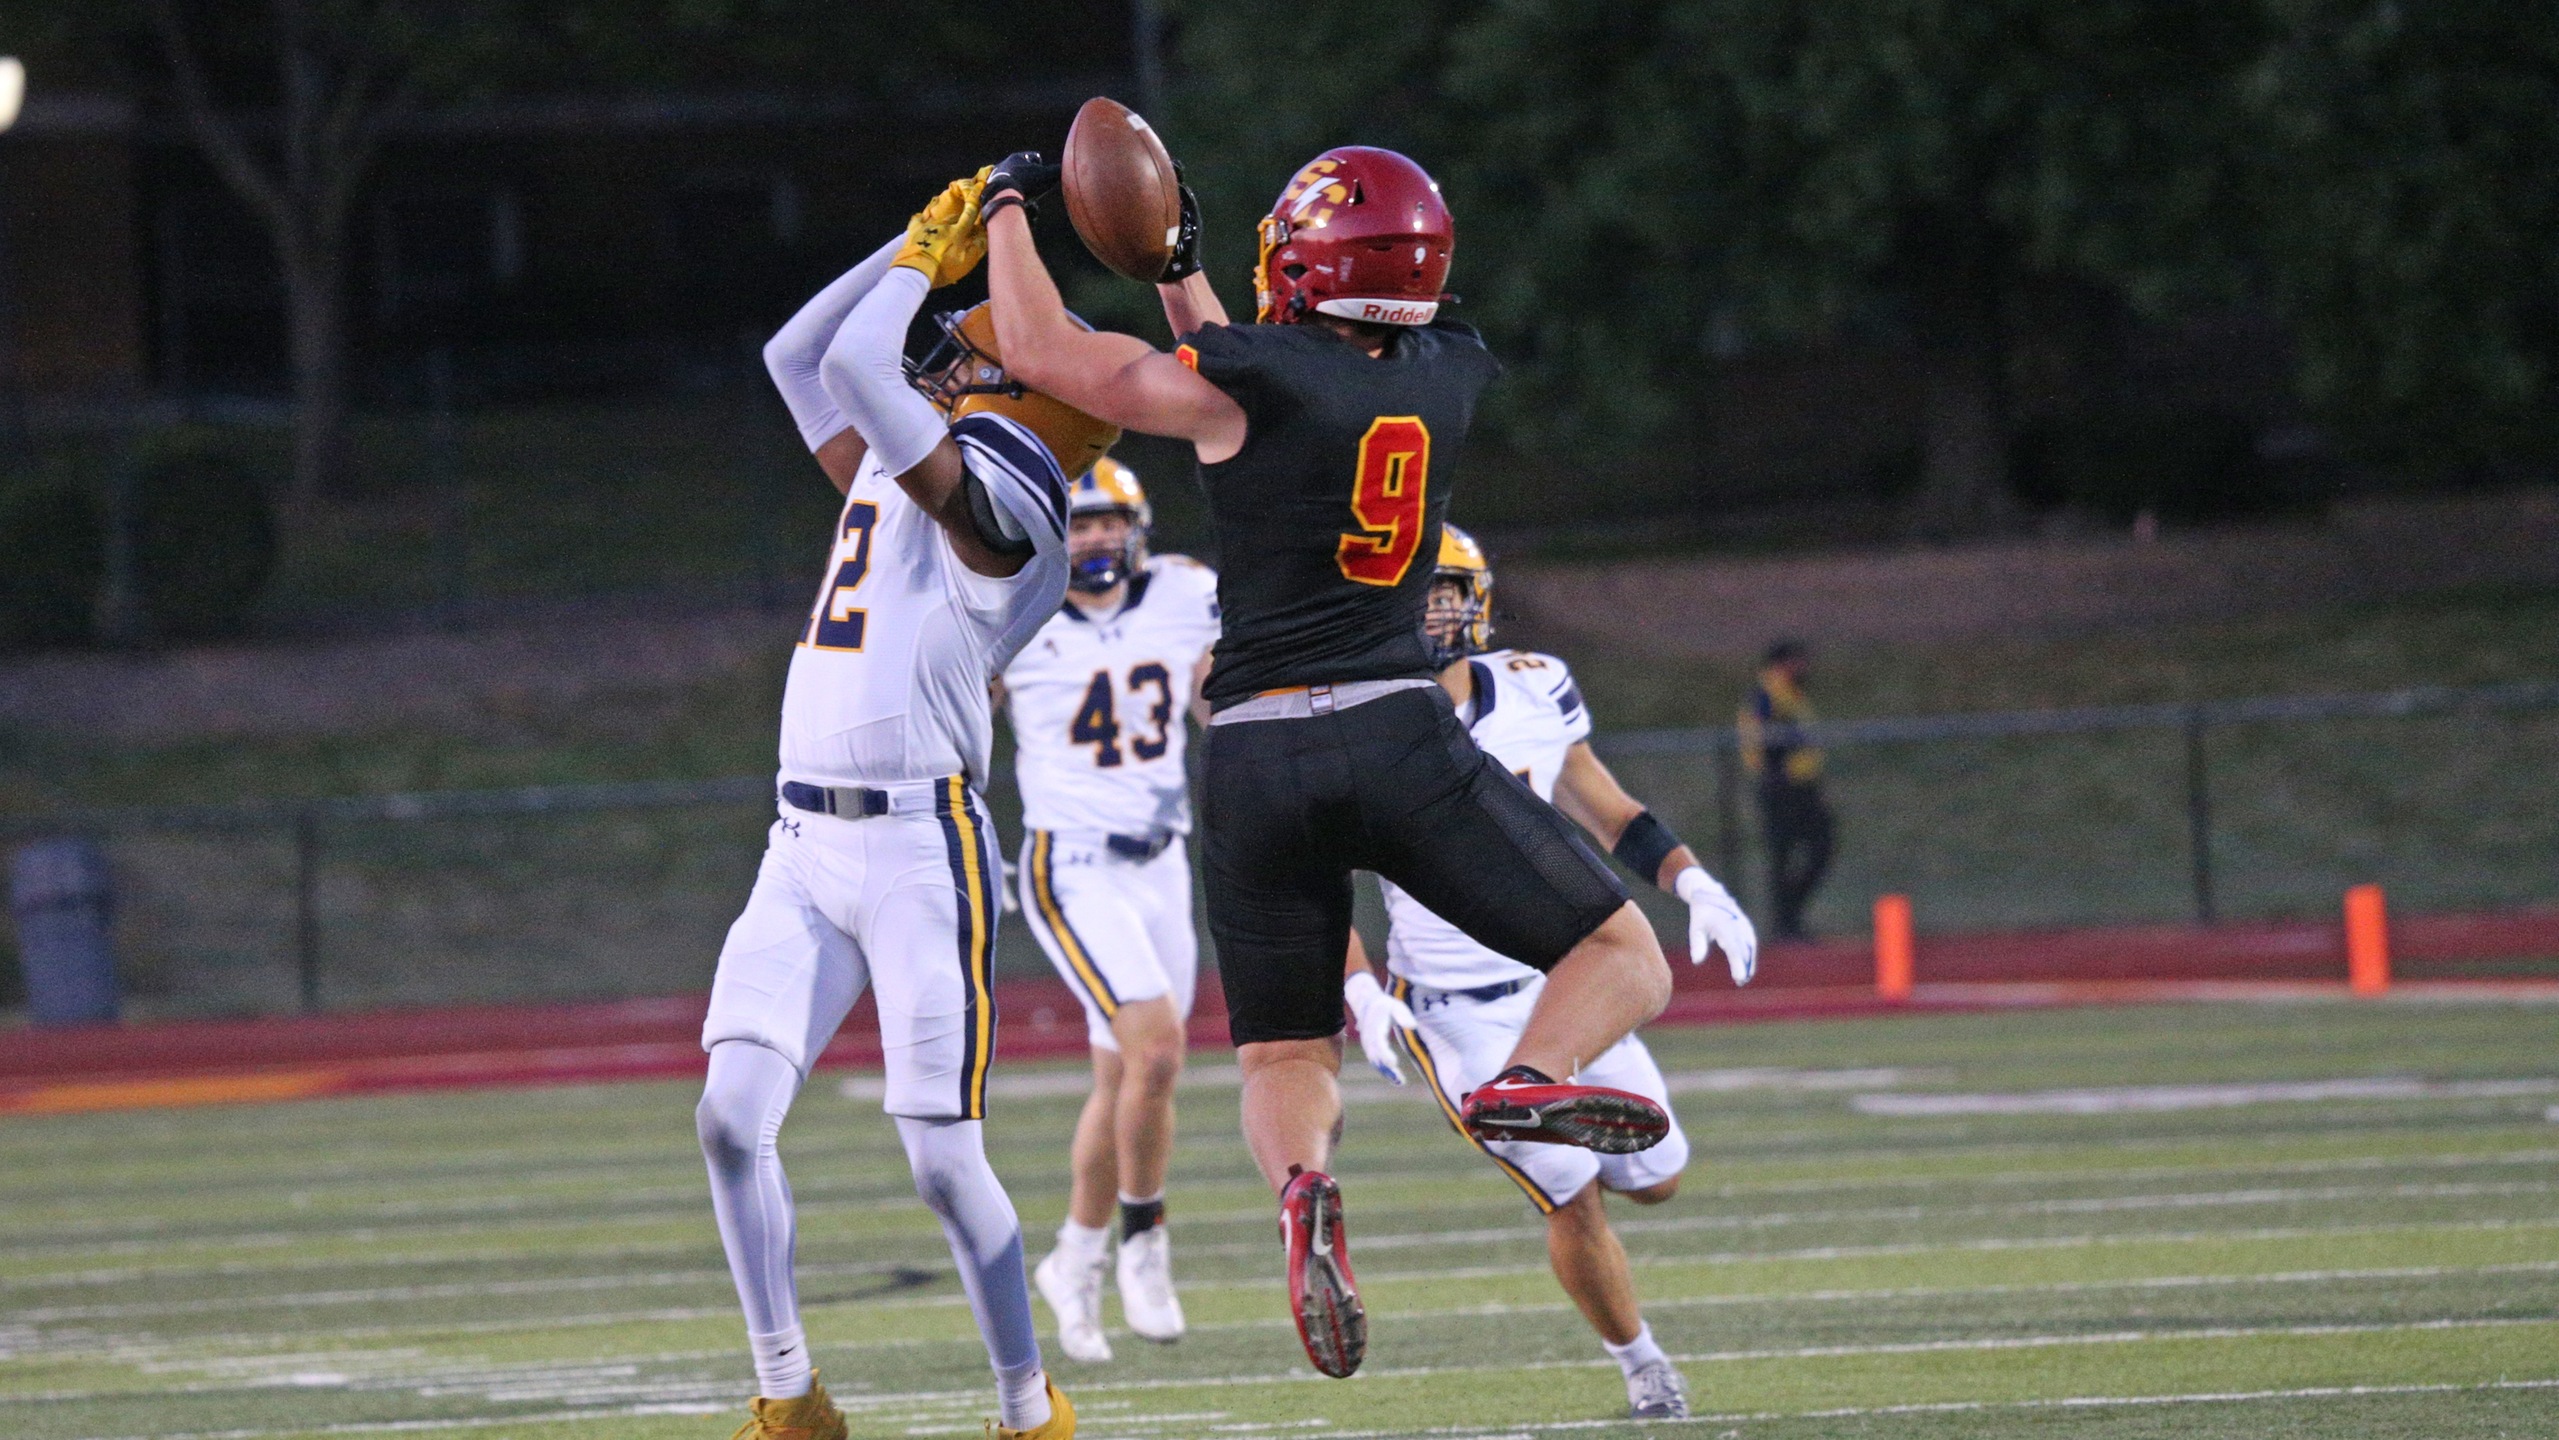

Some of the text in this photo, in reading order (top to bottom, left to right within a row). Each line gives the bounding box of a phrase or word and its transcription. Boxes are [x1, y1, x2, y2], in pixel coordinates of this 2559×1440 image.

[1414, 246, 1427, 265] 9
[1362, 303, 1434, 323] Riddell
[1334, 415, 1431, 587] 9
[1069, 662, 1172, 769] 43
